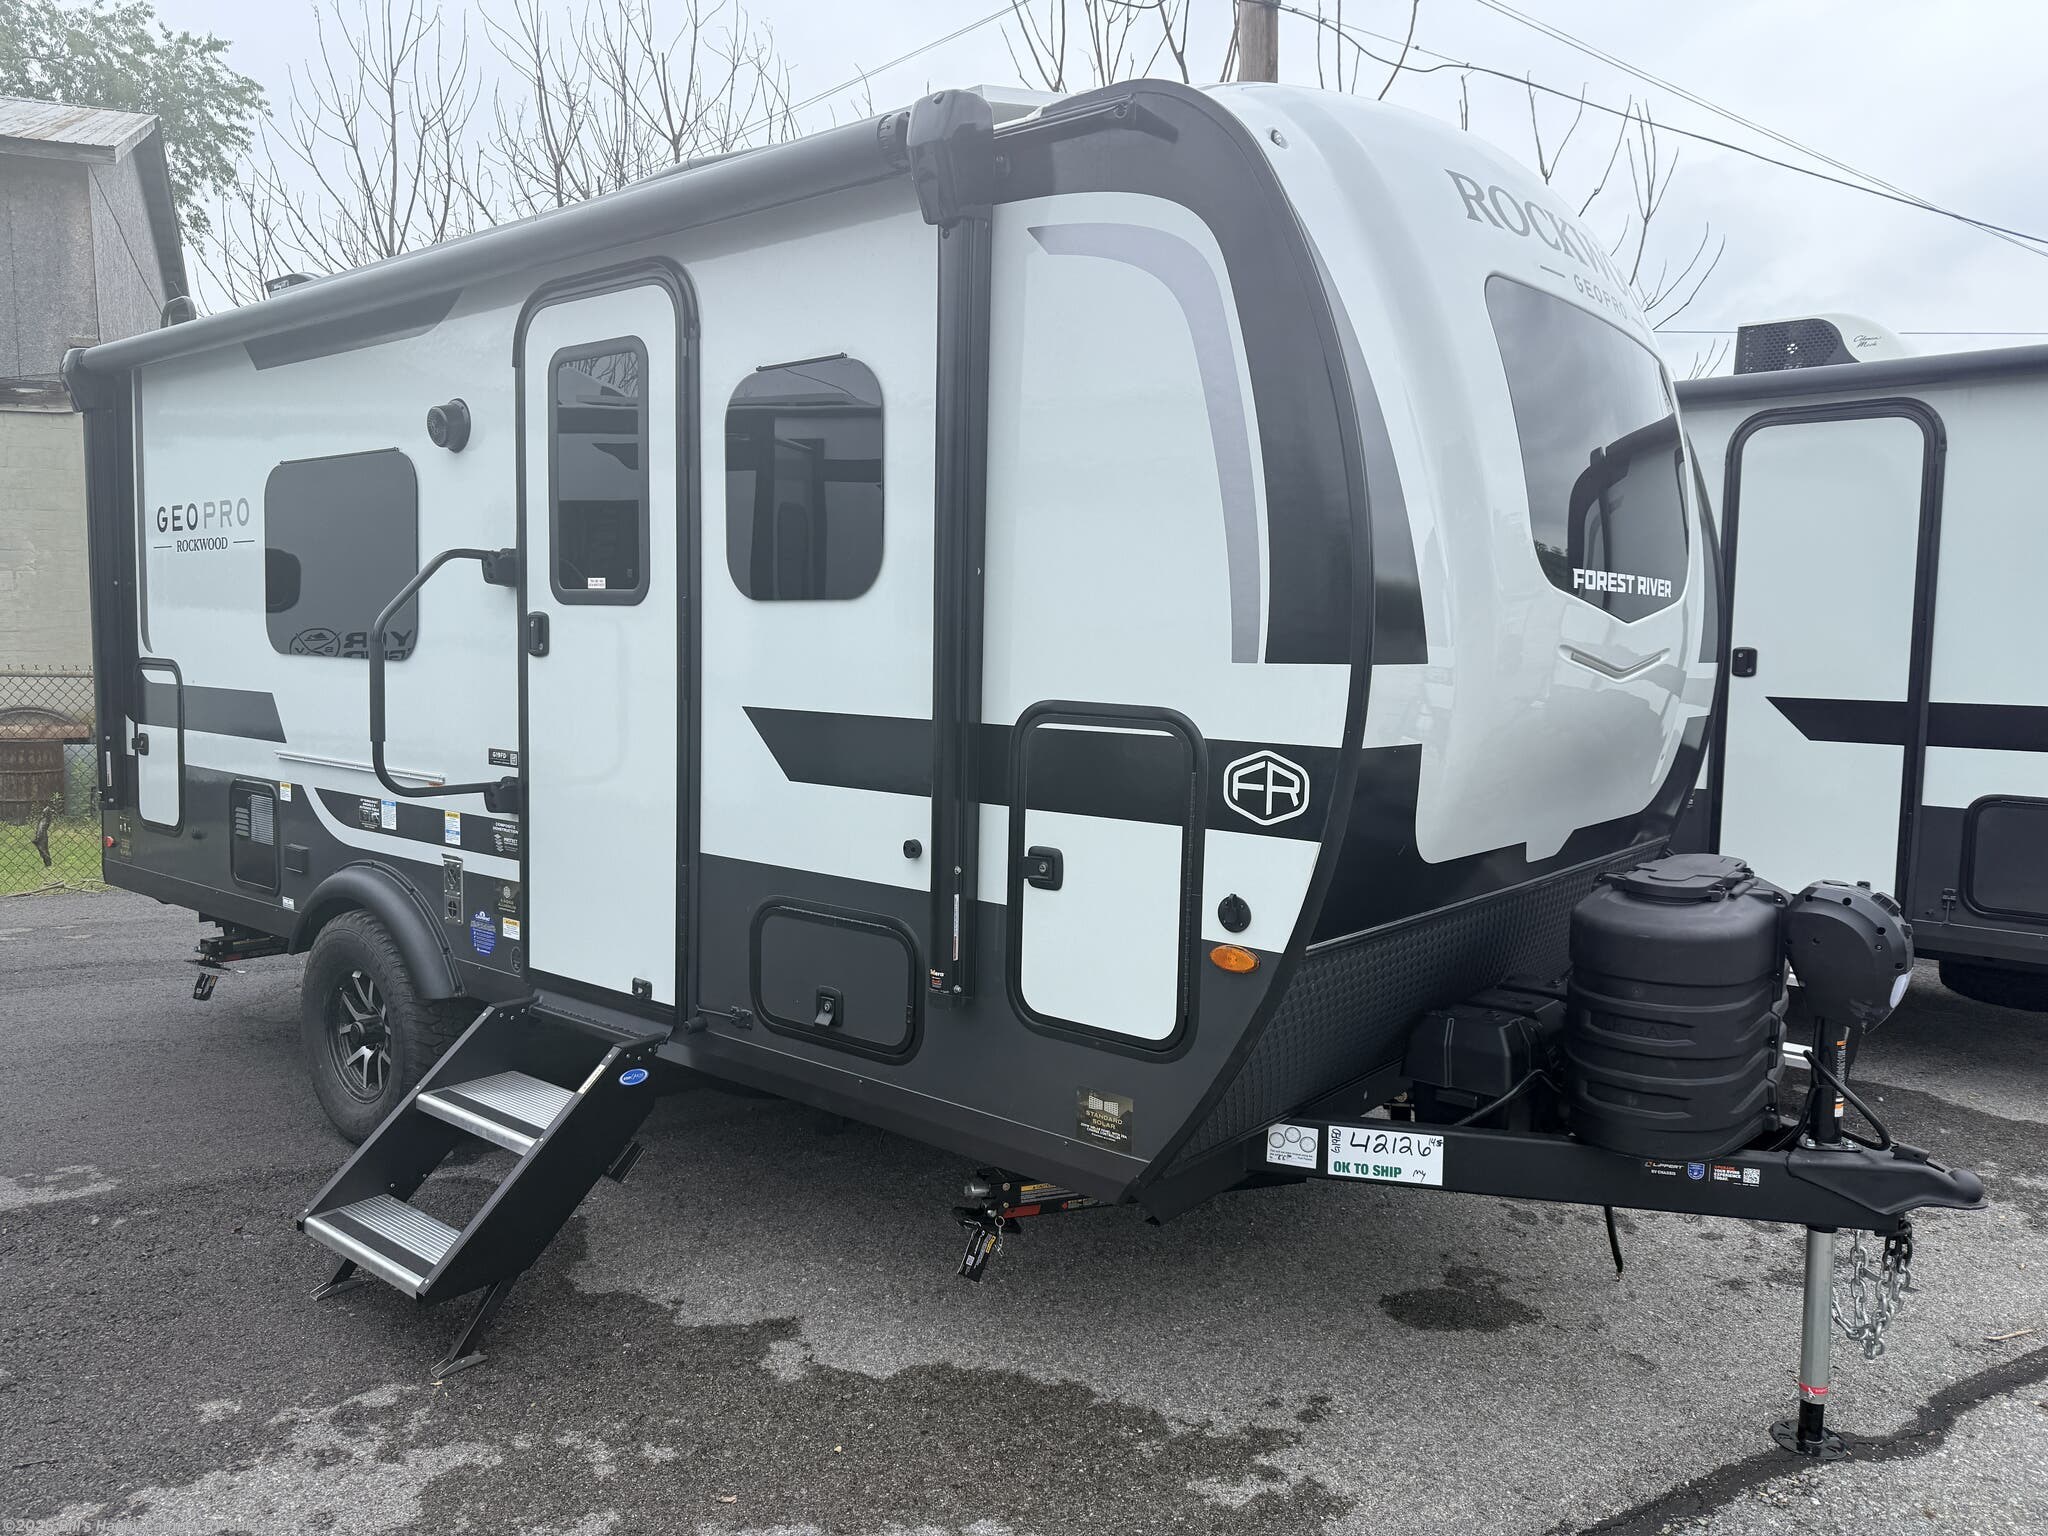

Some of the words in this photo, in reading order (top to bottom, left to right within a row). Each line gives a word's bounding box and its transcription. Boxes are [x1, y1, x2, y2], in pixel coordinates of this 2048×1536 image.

[157, 498, 249, 532] GEOPRO
[176, 537, 228, 552] ROCKWOOD
[1572, 567, 1635, 594] FOREST
[1637, 575, 1672, 599] RIVER
[1085, 1109, 1123, 1125] STANDARD
[1092, 1118, 1116, 1130] SOLAR
[1350, 1132, 1431, 1157] 42126
[1333, 1161, 1351, 1173] OK
[1354, 1163, 1369, 1175] TO
[1372, 1165, 1402, 1178] SHIP
